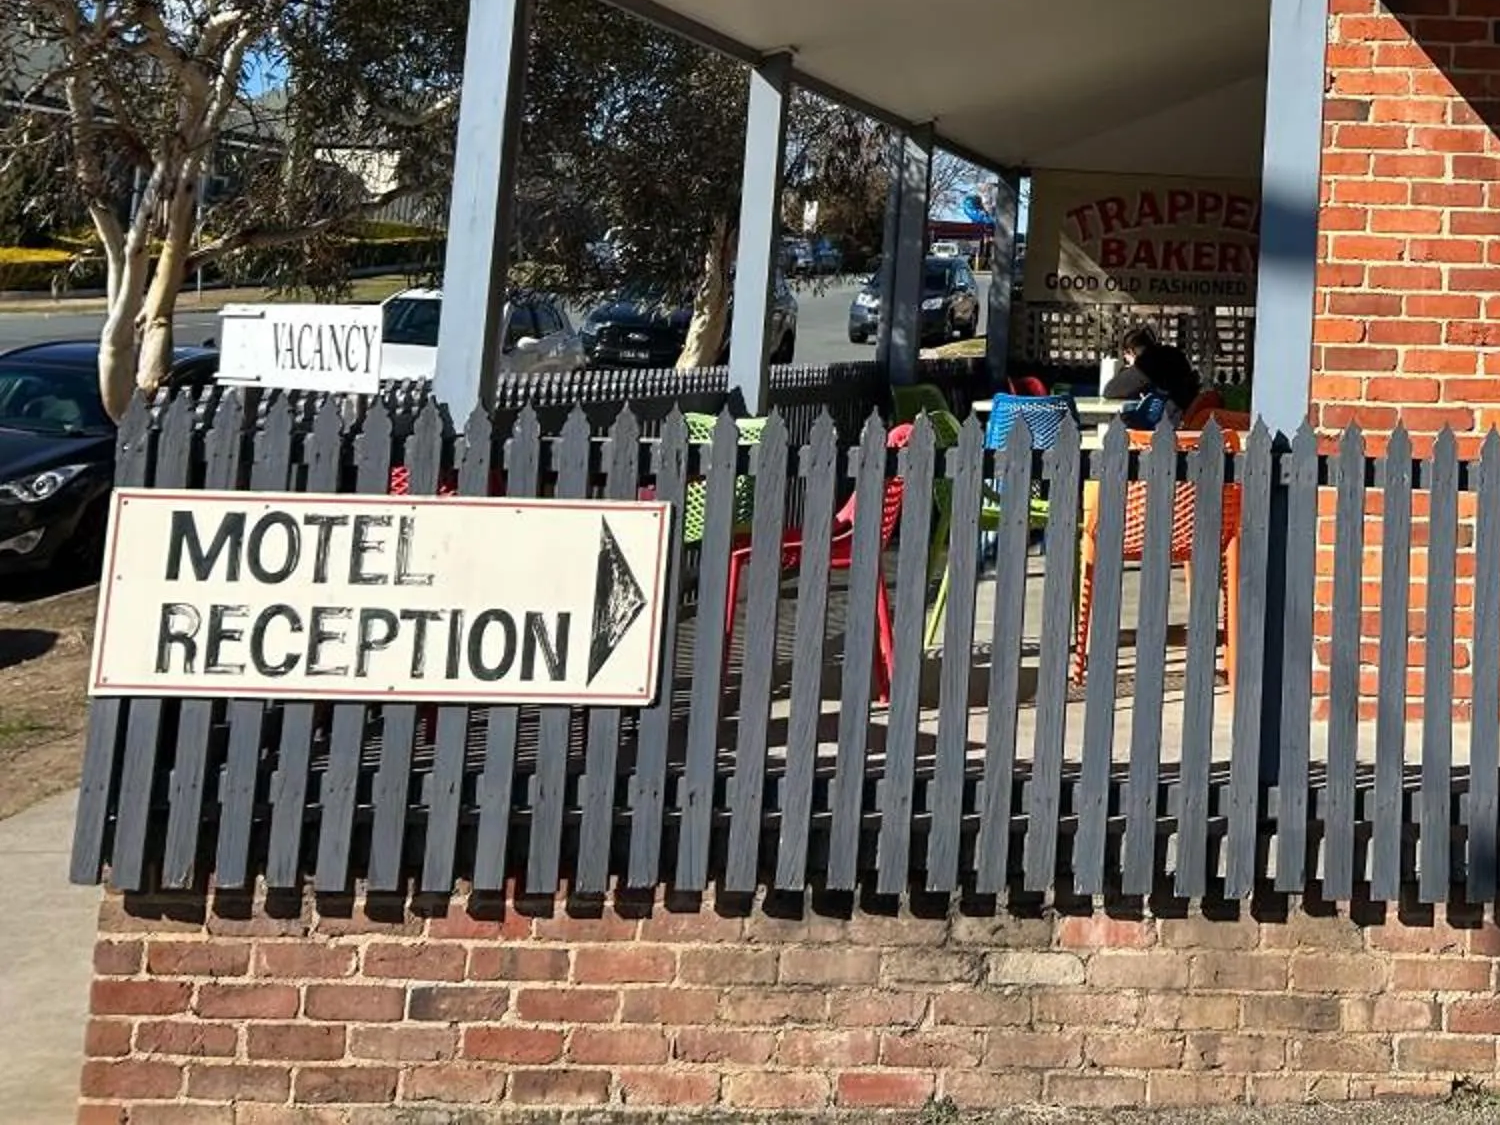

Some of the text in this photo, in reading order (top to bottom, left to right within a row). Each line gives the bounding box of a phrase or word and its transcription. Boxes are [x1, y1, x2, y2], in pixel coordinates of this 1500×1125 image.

[1045, 272, 1247, 296] GOOD OLD FASHIONED
[273, 322, 377, 373] VACANCY
[165, 510, 434, 586] MOTEL
[154, 602, 571, 682] RECEPTION
